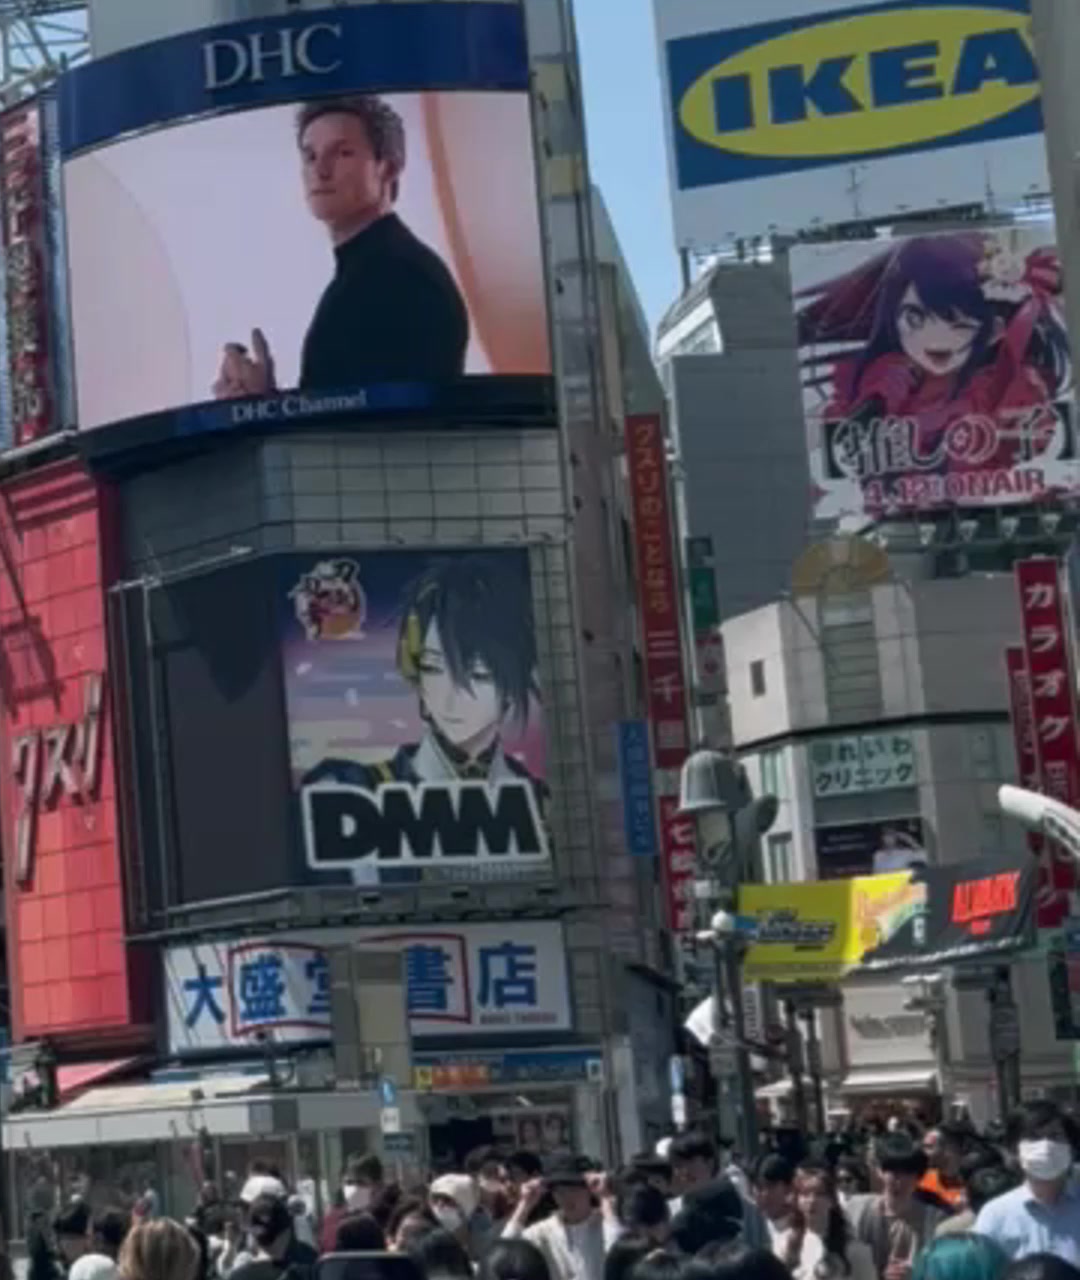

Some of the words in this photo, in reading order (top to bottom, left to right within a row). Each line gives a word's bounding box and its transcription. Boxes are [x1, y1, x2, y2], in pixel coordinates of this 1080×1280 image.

[203, 24, 342, 89] DHC
[712, 28, 1042, 135] IKEA
[231, 401, 277, 422] DHC
[815, 762, 914, 793] クリニック
[307, 784, 543, 862] DMM
